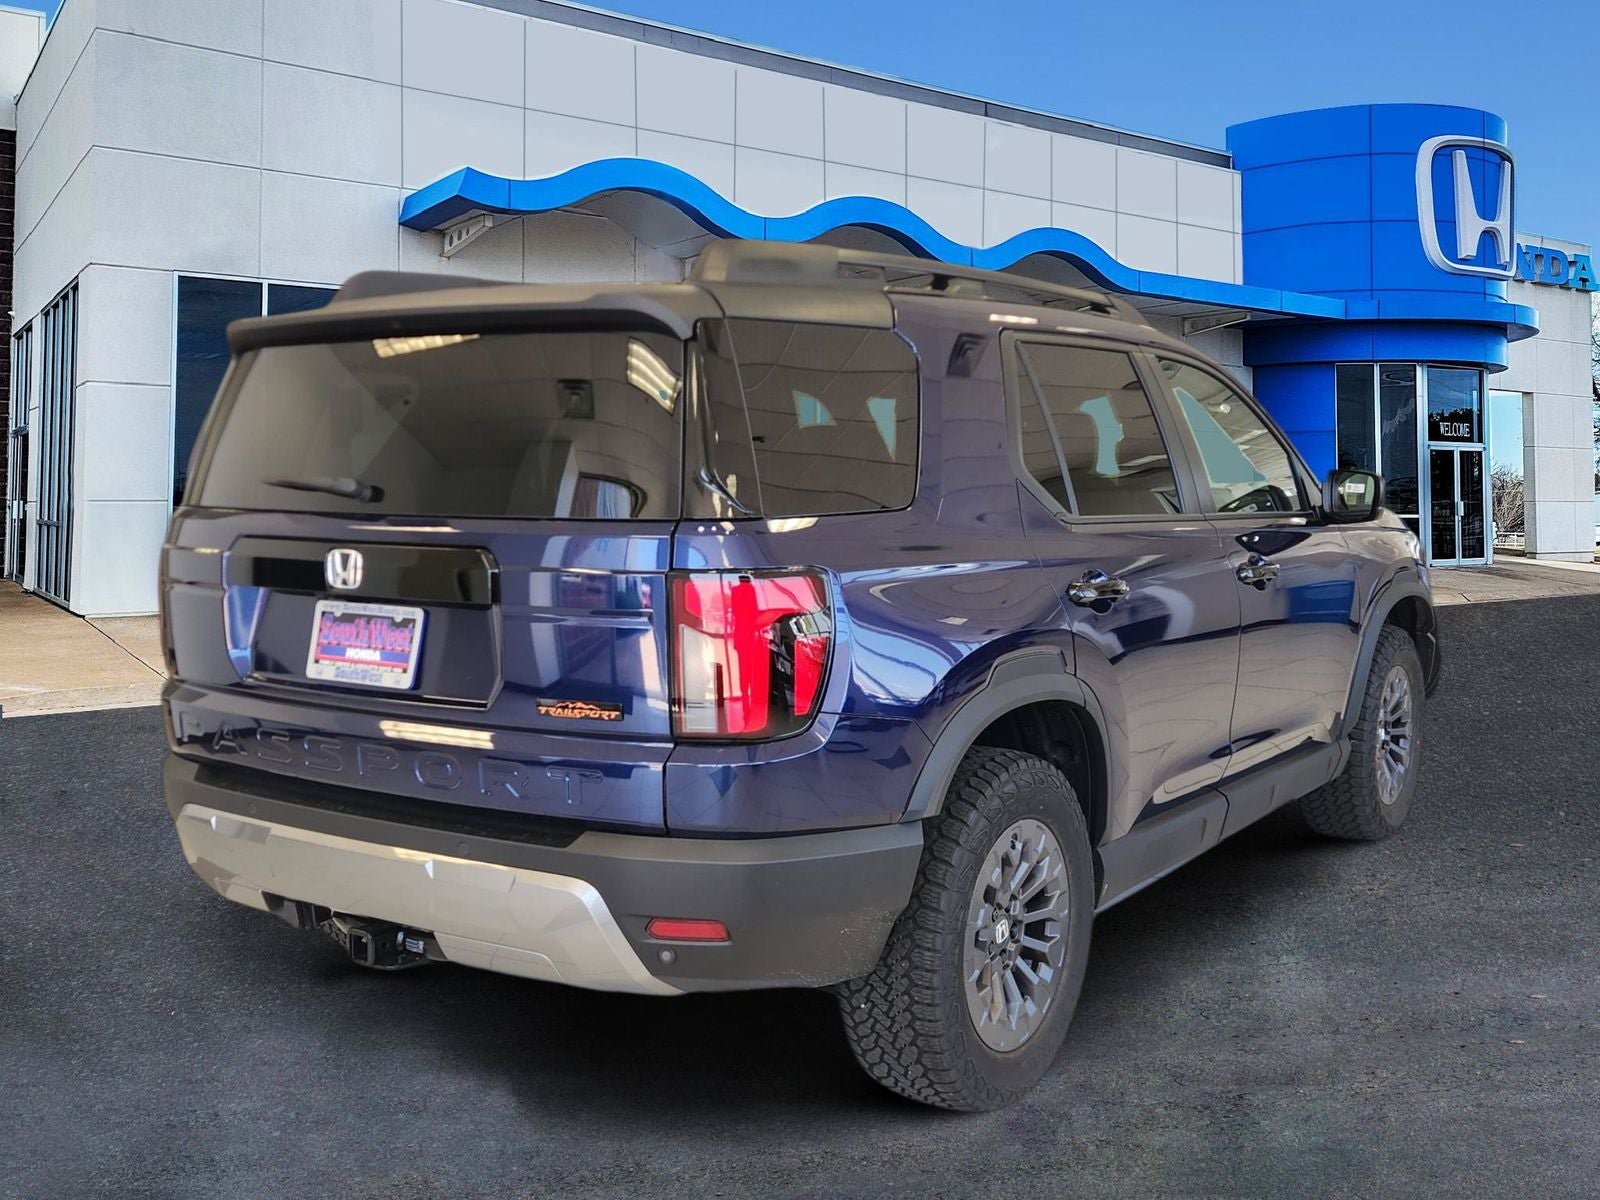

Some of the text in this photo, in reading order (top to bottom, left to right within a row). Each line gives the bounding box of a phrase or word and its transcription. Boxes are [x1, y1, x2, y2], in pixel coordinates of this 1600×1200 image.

[1514, 243, 1600, 292] NDA
[1439, 421, 1471, 437] WELCOME
[345, 647, 381, 661] HONDA
[537, 706, 620, 721] TRAILSPORT
